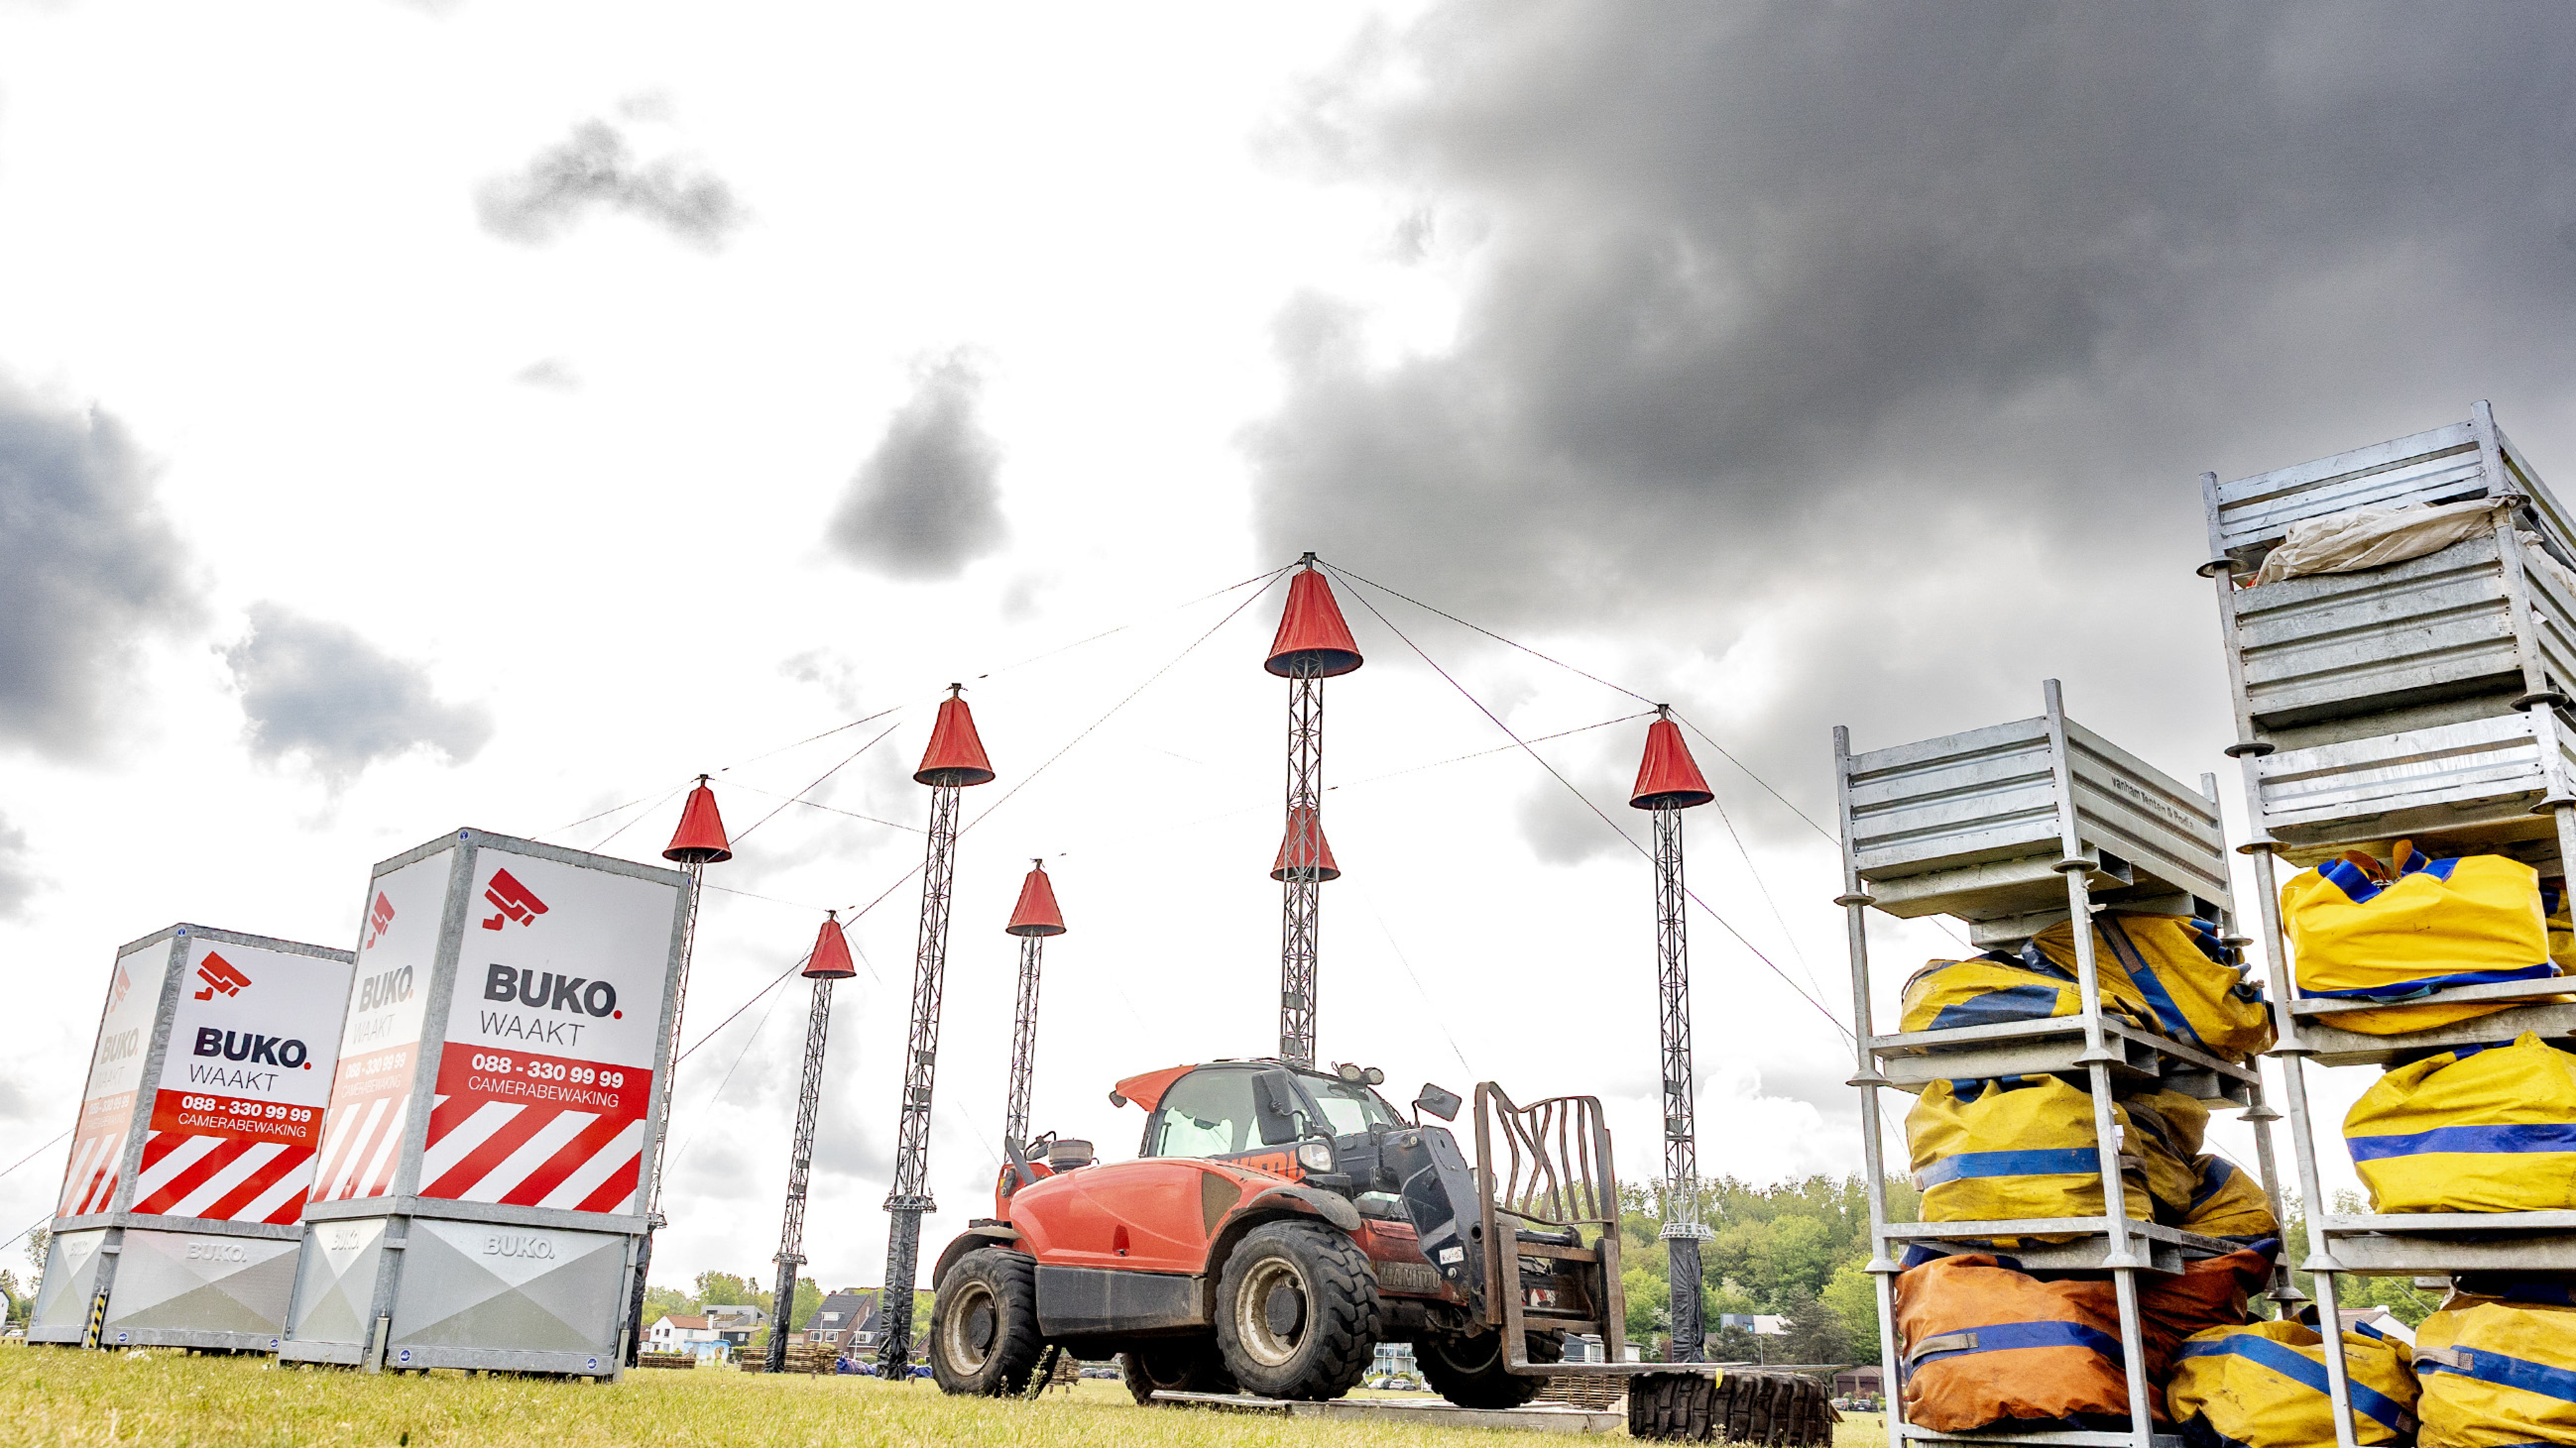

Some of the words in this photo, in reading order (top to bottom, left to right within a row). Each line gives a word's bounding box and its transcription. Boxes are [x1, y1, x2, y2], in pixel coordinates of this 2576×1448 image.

[358, 965, 414, 1013] BUKO.
[484, 963, 623, 1019] BUKO.
[353, 1013, 395, 1045] WAAKT
[481, 1010, 585, 1046] WAAKT
[193, 1026, 311, 1070] BUKO.
[190, 1064, 279, 1092] WAAKT
[345, 1062, 362, 1080] 088
[366, 1058, 382, 1075] 330
[382, 1054, 394, 1072] 99
[394, 1052, 407, 1068] 99
[472, 1053, 512, 1073] 088
[527, 1061, 566, 1081] 330
[570, 1066, 595, 1084] 99
[599, 1070, 624, 1089] 99
[468, 1076, 619, 1108] CAMERABEWAKING
[178, 1112, 307, 1137] CAMERABEWAKING
[182, 1095, 217, 1111] 088
[229, 1101, 262, 1117] 330
[265, 1105, 287, 1119] 99
[289, 1108, 312, 1123] 99
[186, 1241, 248, 1262] BUKO.
[483, 1233, 556, 1260] BUKO.
